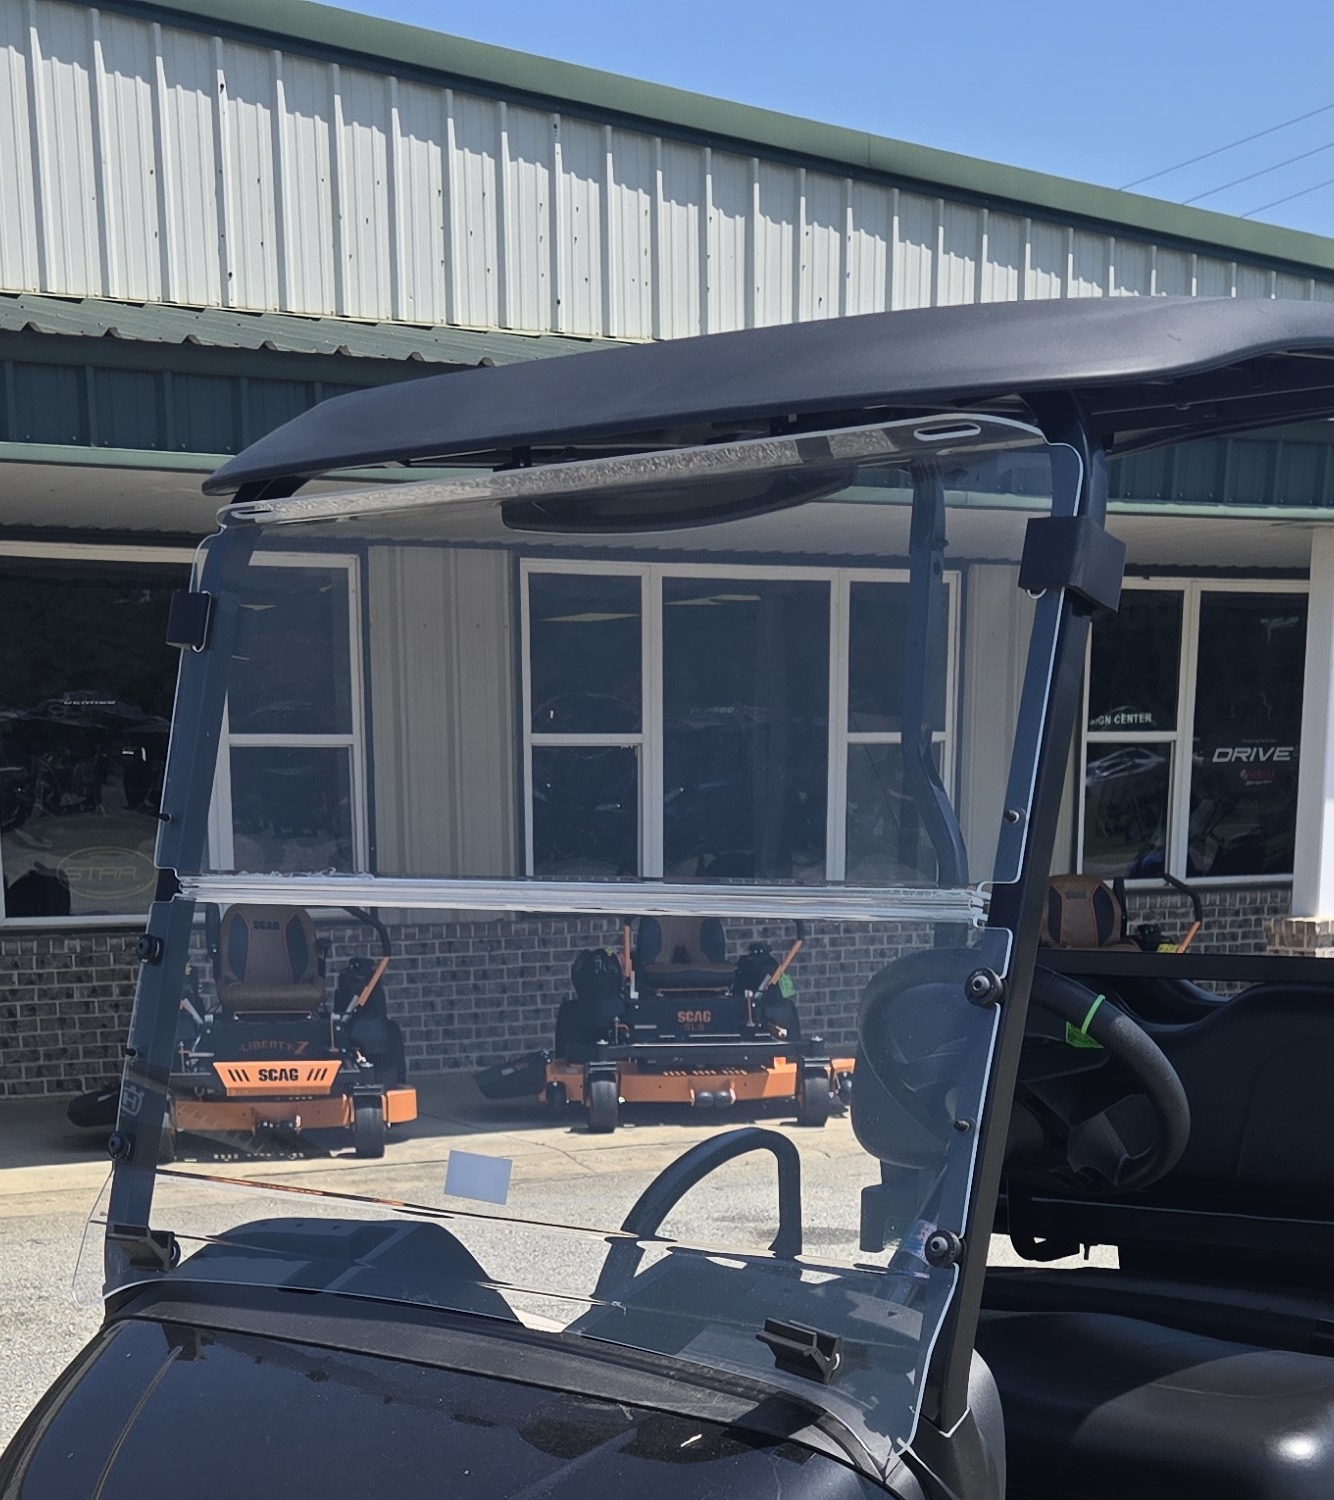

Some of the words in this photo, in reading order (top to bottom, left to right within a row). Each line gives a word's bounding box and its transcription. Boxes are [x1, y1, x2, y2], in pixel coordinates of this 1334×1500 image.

[1114, 713, 1152, 724] CENTER
[1212, 747, 1294, 763] DRIVE
[677, 1010, 712, 1023] SCAG
[258, 1068, 299, 1082] SCAG
